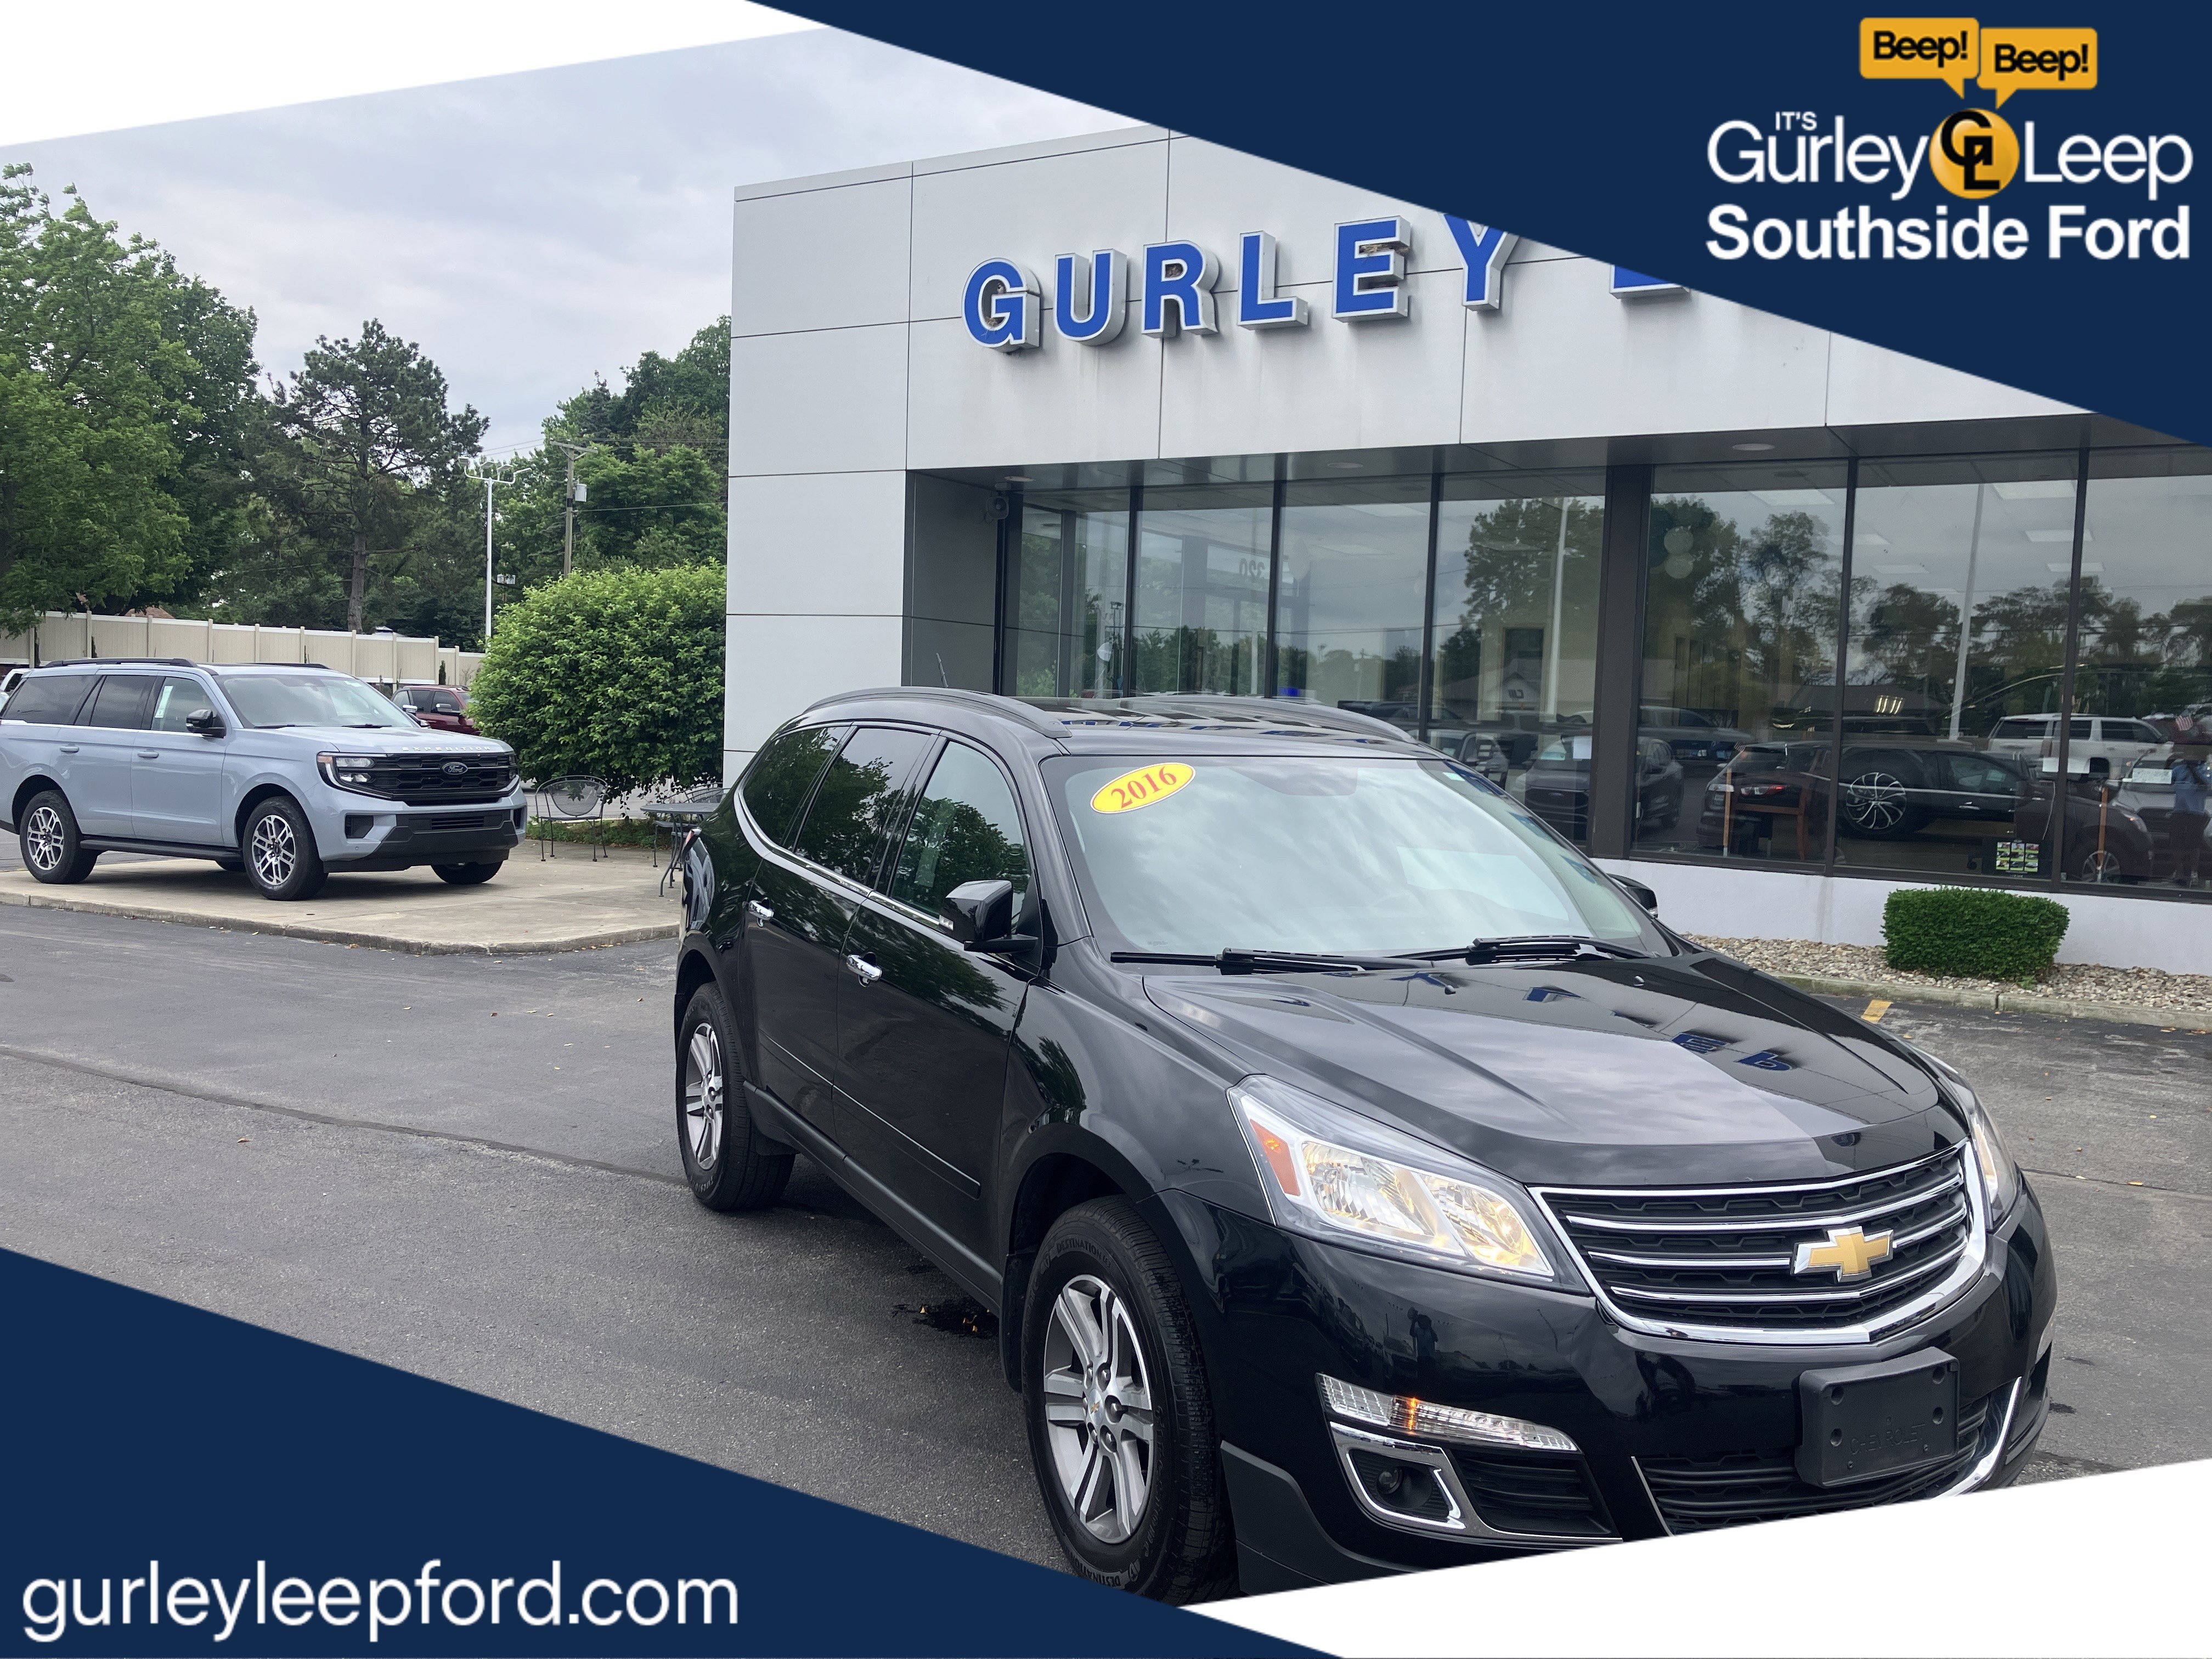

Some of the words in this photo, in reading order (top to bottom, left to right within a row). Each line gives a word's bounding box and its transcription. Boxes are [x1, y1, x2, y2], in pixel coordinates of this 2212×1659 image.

[961, 212, 1519, 351] GURLEY
[447, 764, 464, 773] Ford
[1111, 765, 1177, 809] 2016
[1056, 1238, 1102, 1261] DESTINATION
